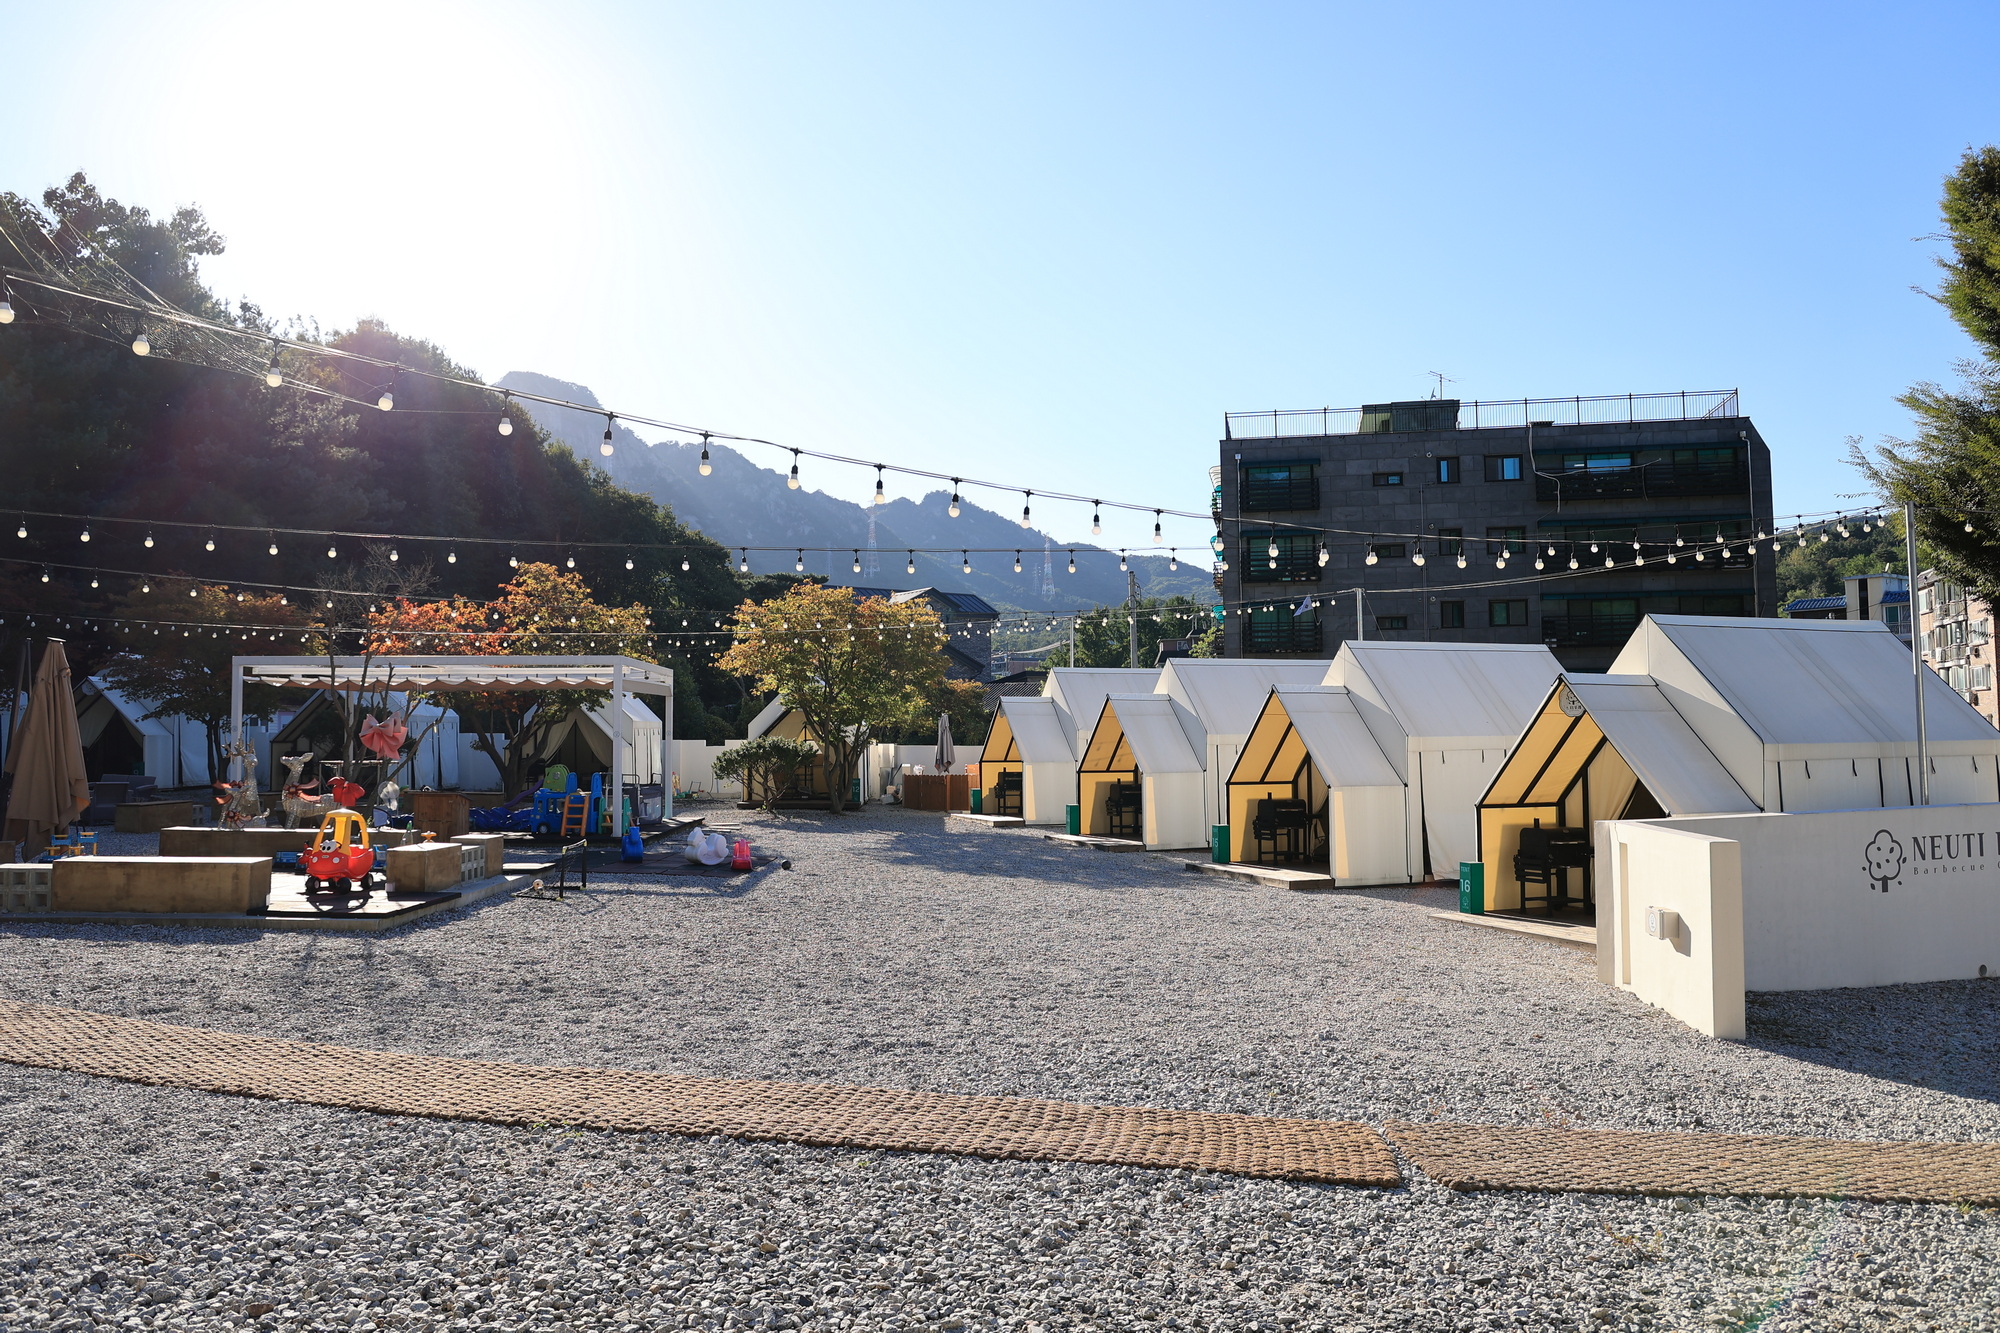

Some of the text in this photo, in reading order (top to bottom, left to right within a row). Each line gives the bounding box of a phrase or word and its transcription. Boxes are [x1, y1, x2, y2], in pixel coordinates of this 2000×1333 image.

[1212, 837, 1219, 848] 15
[1911, 832, 1985, 861] NEUTI
[1913, 863, 1985, 875] Barbecue
[1459, 878, 1471, 893] 16
